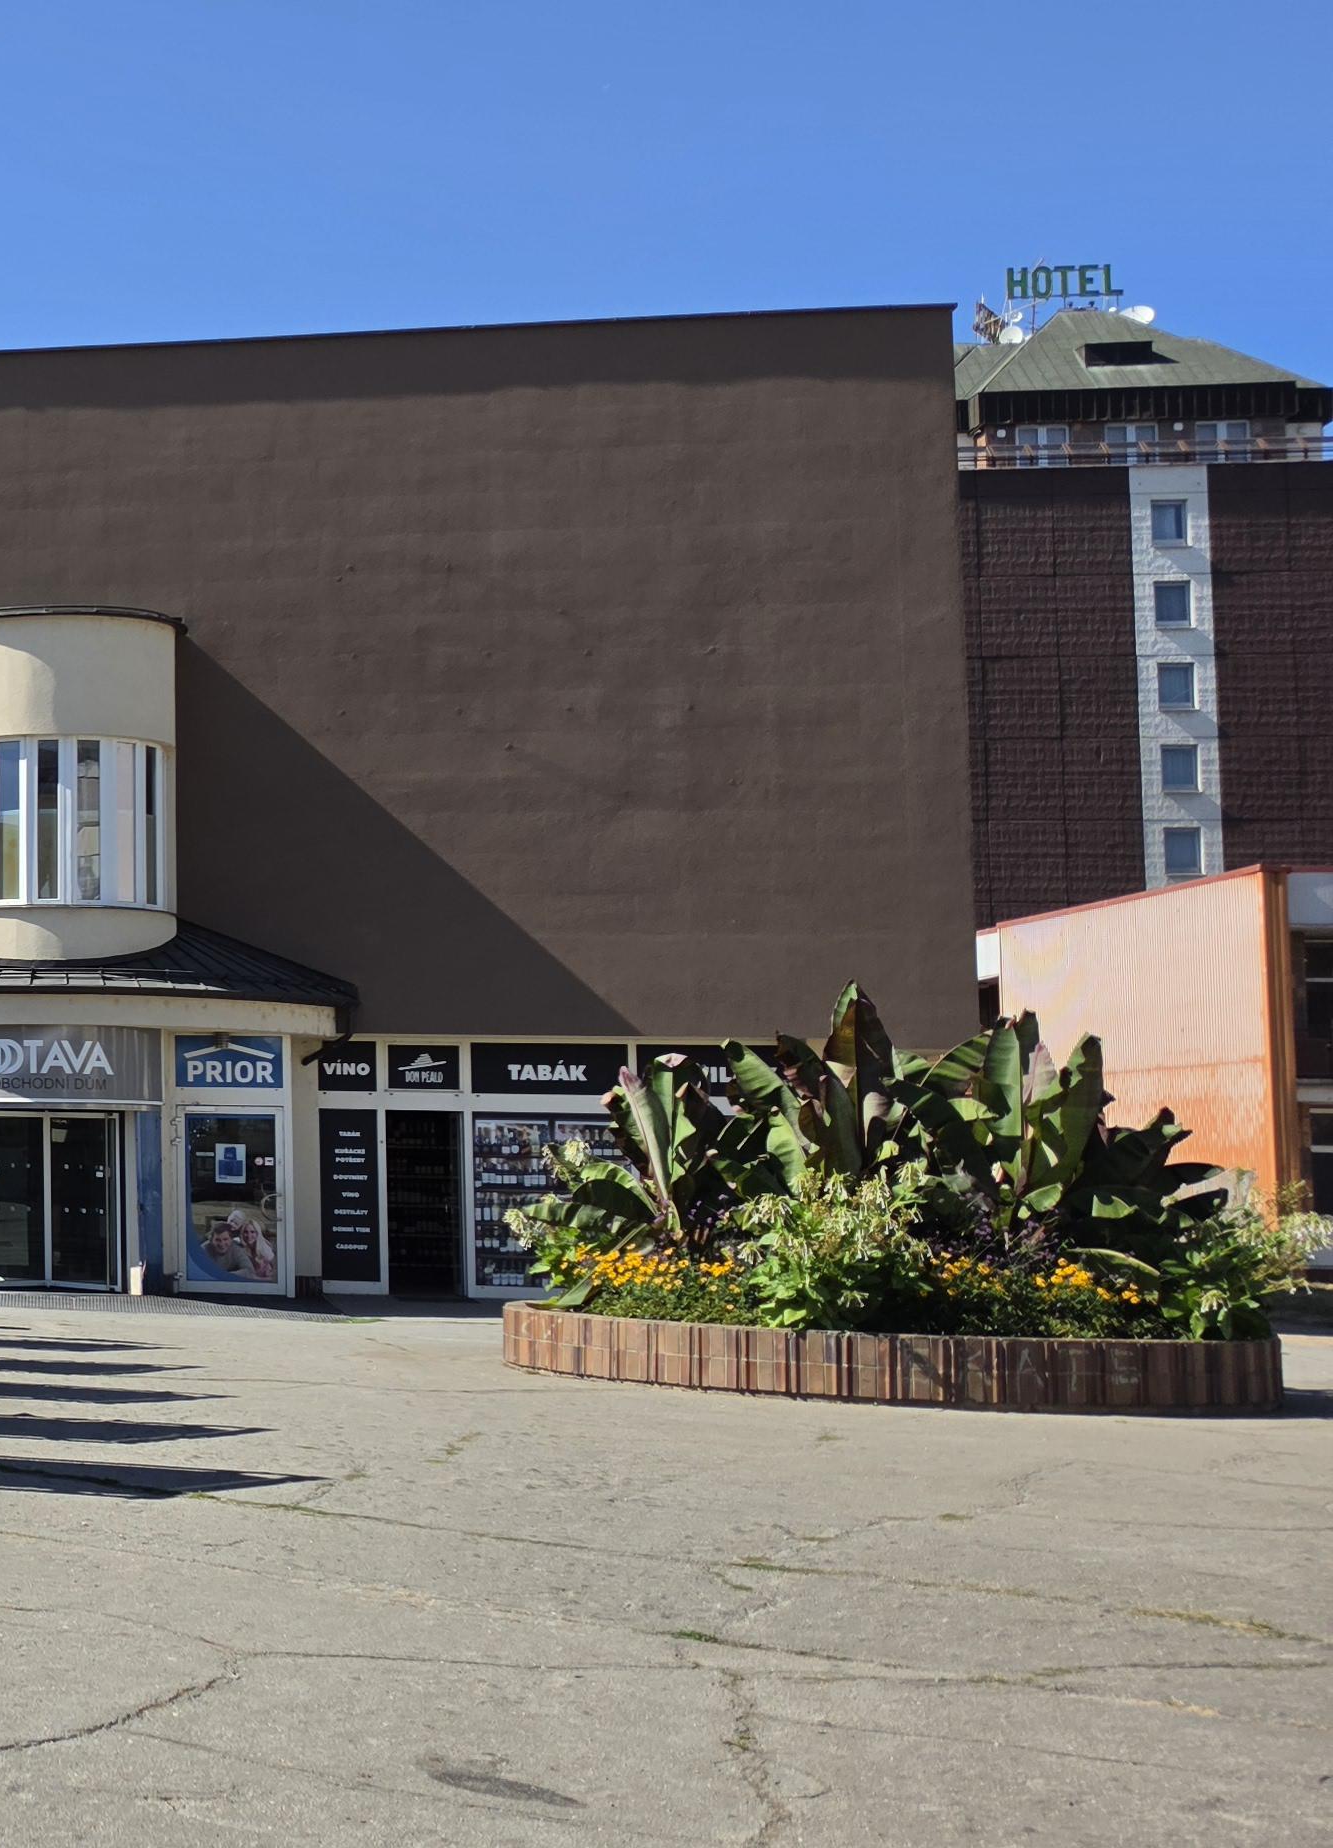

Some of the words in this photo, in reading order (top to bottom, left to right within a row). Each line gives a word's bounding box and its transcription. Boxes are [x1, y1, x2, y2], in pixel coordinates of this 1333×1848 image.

[1006, 264, 1124, 299] HOTEL
[186, 1060, 275, 1084] PRIOR
[322, 1058, 371, 1077] VÍNO
[507, 1058, 587, 1082] TABÁK
[73, 1075, 108, 1091] DŮM
